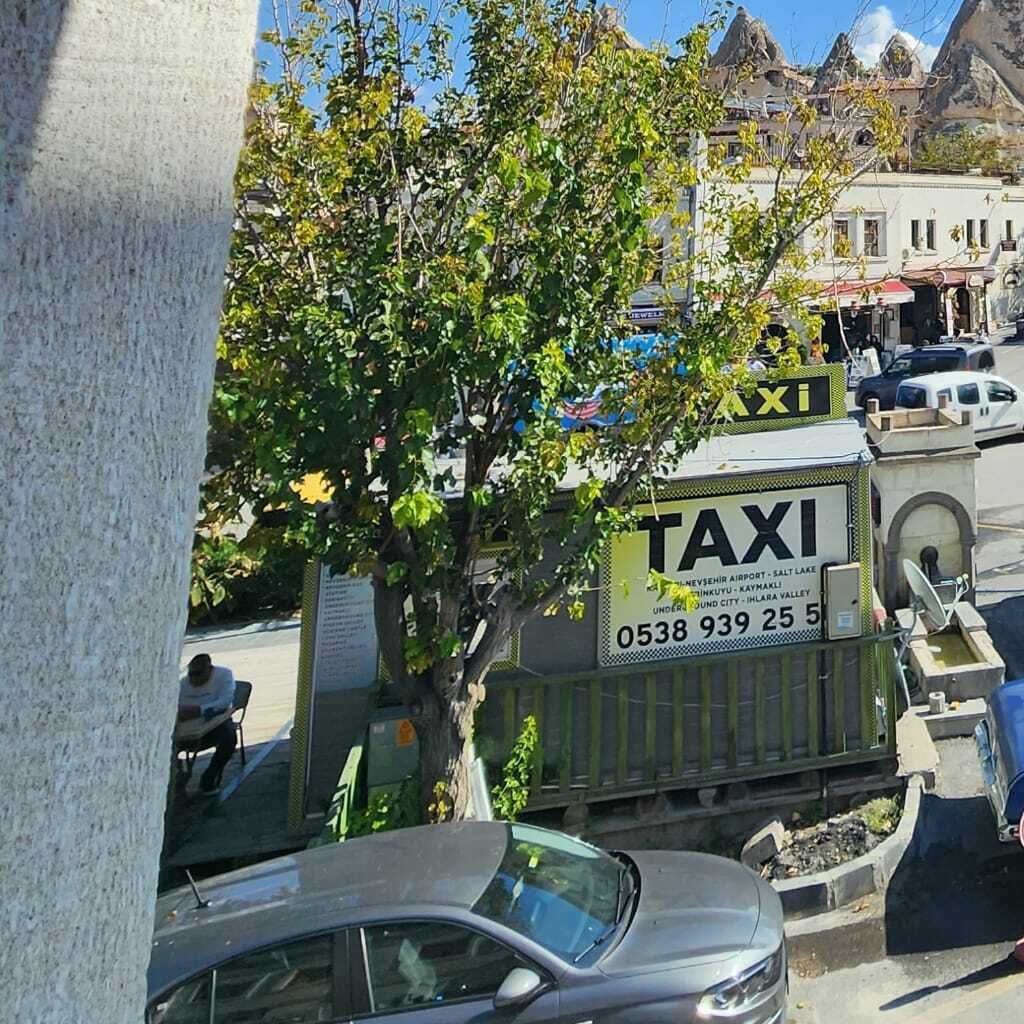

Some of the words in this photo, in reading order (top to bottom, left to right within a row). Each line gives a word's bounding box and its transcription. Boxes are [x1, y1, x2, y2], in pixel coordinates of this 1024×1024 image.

[711, 383, 810, 420] AXi
[634, 498, 817, 574] TAXI
[730, 571, 766, 582] AIRPORT
[774, 568, 793, 577] SALT
[795, 566, 816, 575] LAKE
[740, 581, 782, 593] KAYMAKLI
[720, 598, 740, 608] CITY
[747, 593, 778, 604] IHLARA
[780, 589, 810, 600] VALLEY
[617, 619, 688, 649] 0538
[700, 611, 750, 639] 939
[762, 606, 795, 631] 25
[806, 603, 821, 626] 5
